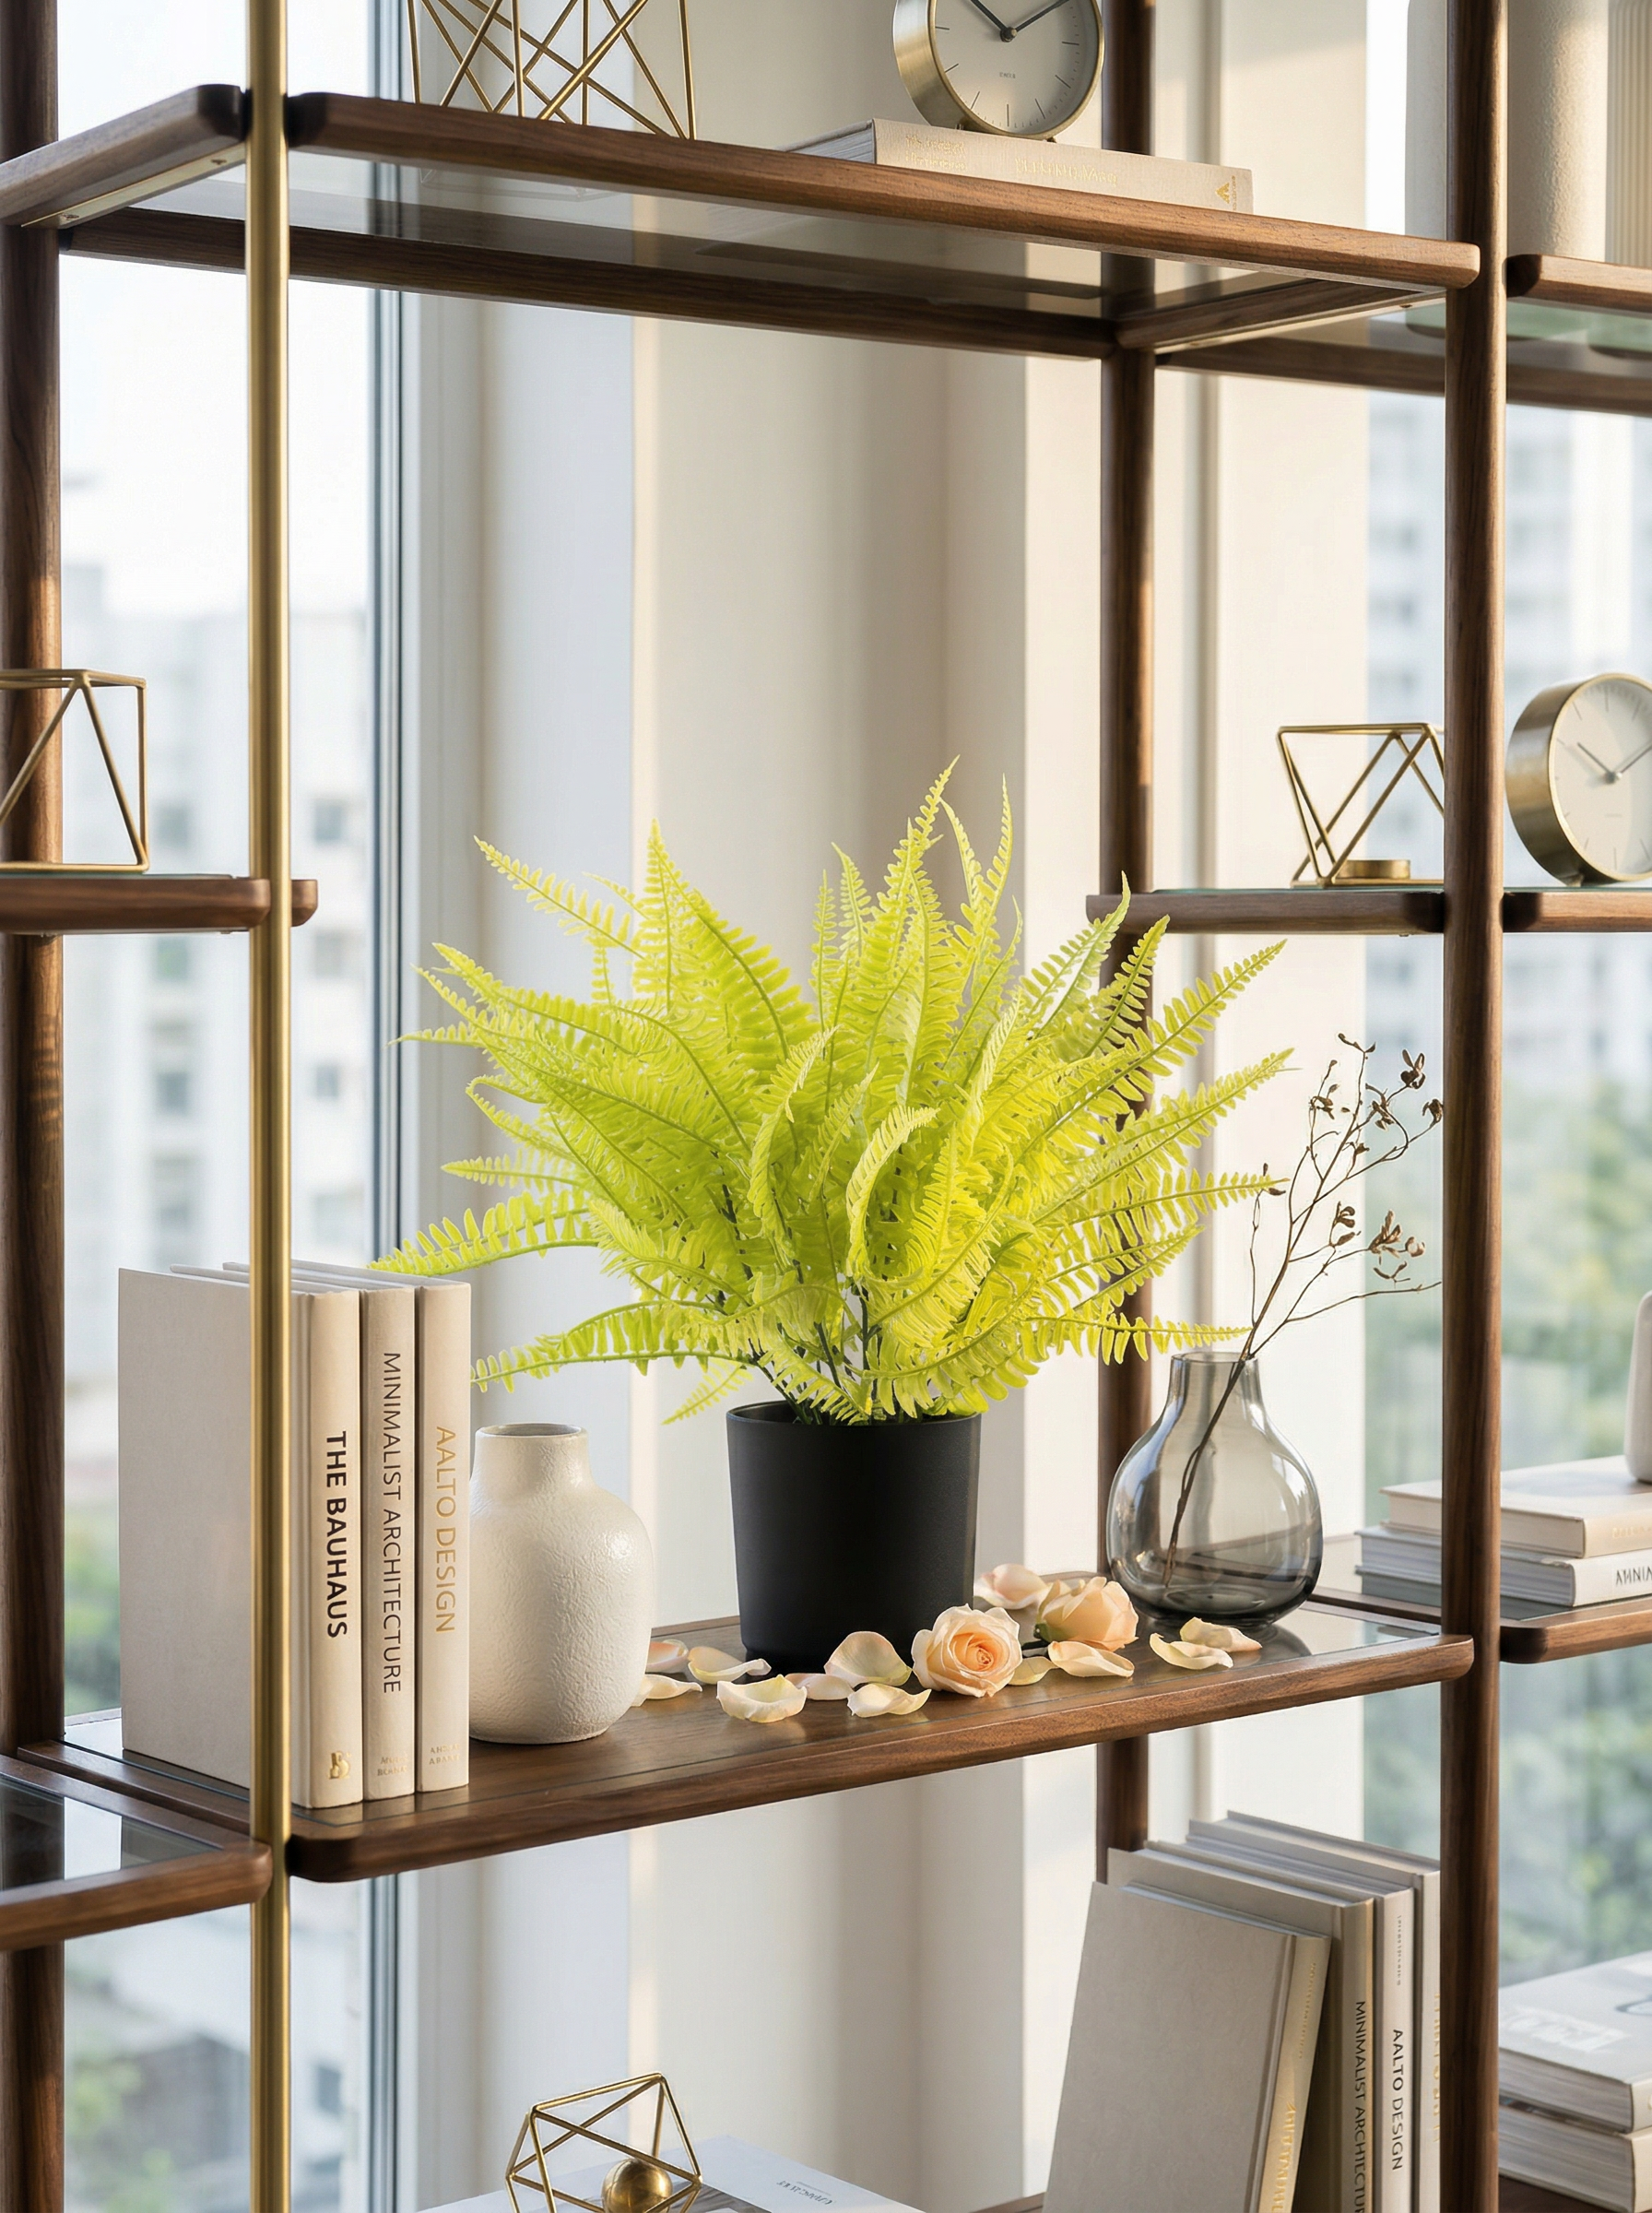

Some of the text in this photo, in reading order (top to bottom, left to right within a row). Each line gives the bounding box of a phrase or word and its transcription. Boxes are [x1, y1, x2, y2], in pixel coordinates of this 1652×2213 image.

[326, 1430, 348, 1638] THE BAUHAUS
[383, 1352, 402, 1694] MINIMALIST ARCHITECTURE
[435, 1426, 457, 1633] AALTO DESIGN
[1354, 2000, 1367, 2101] MINIMALIST
[1391, 2029, 1404, 2171] AALTO DESIGN
